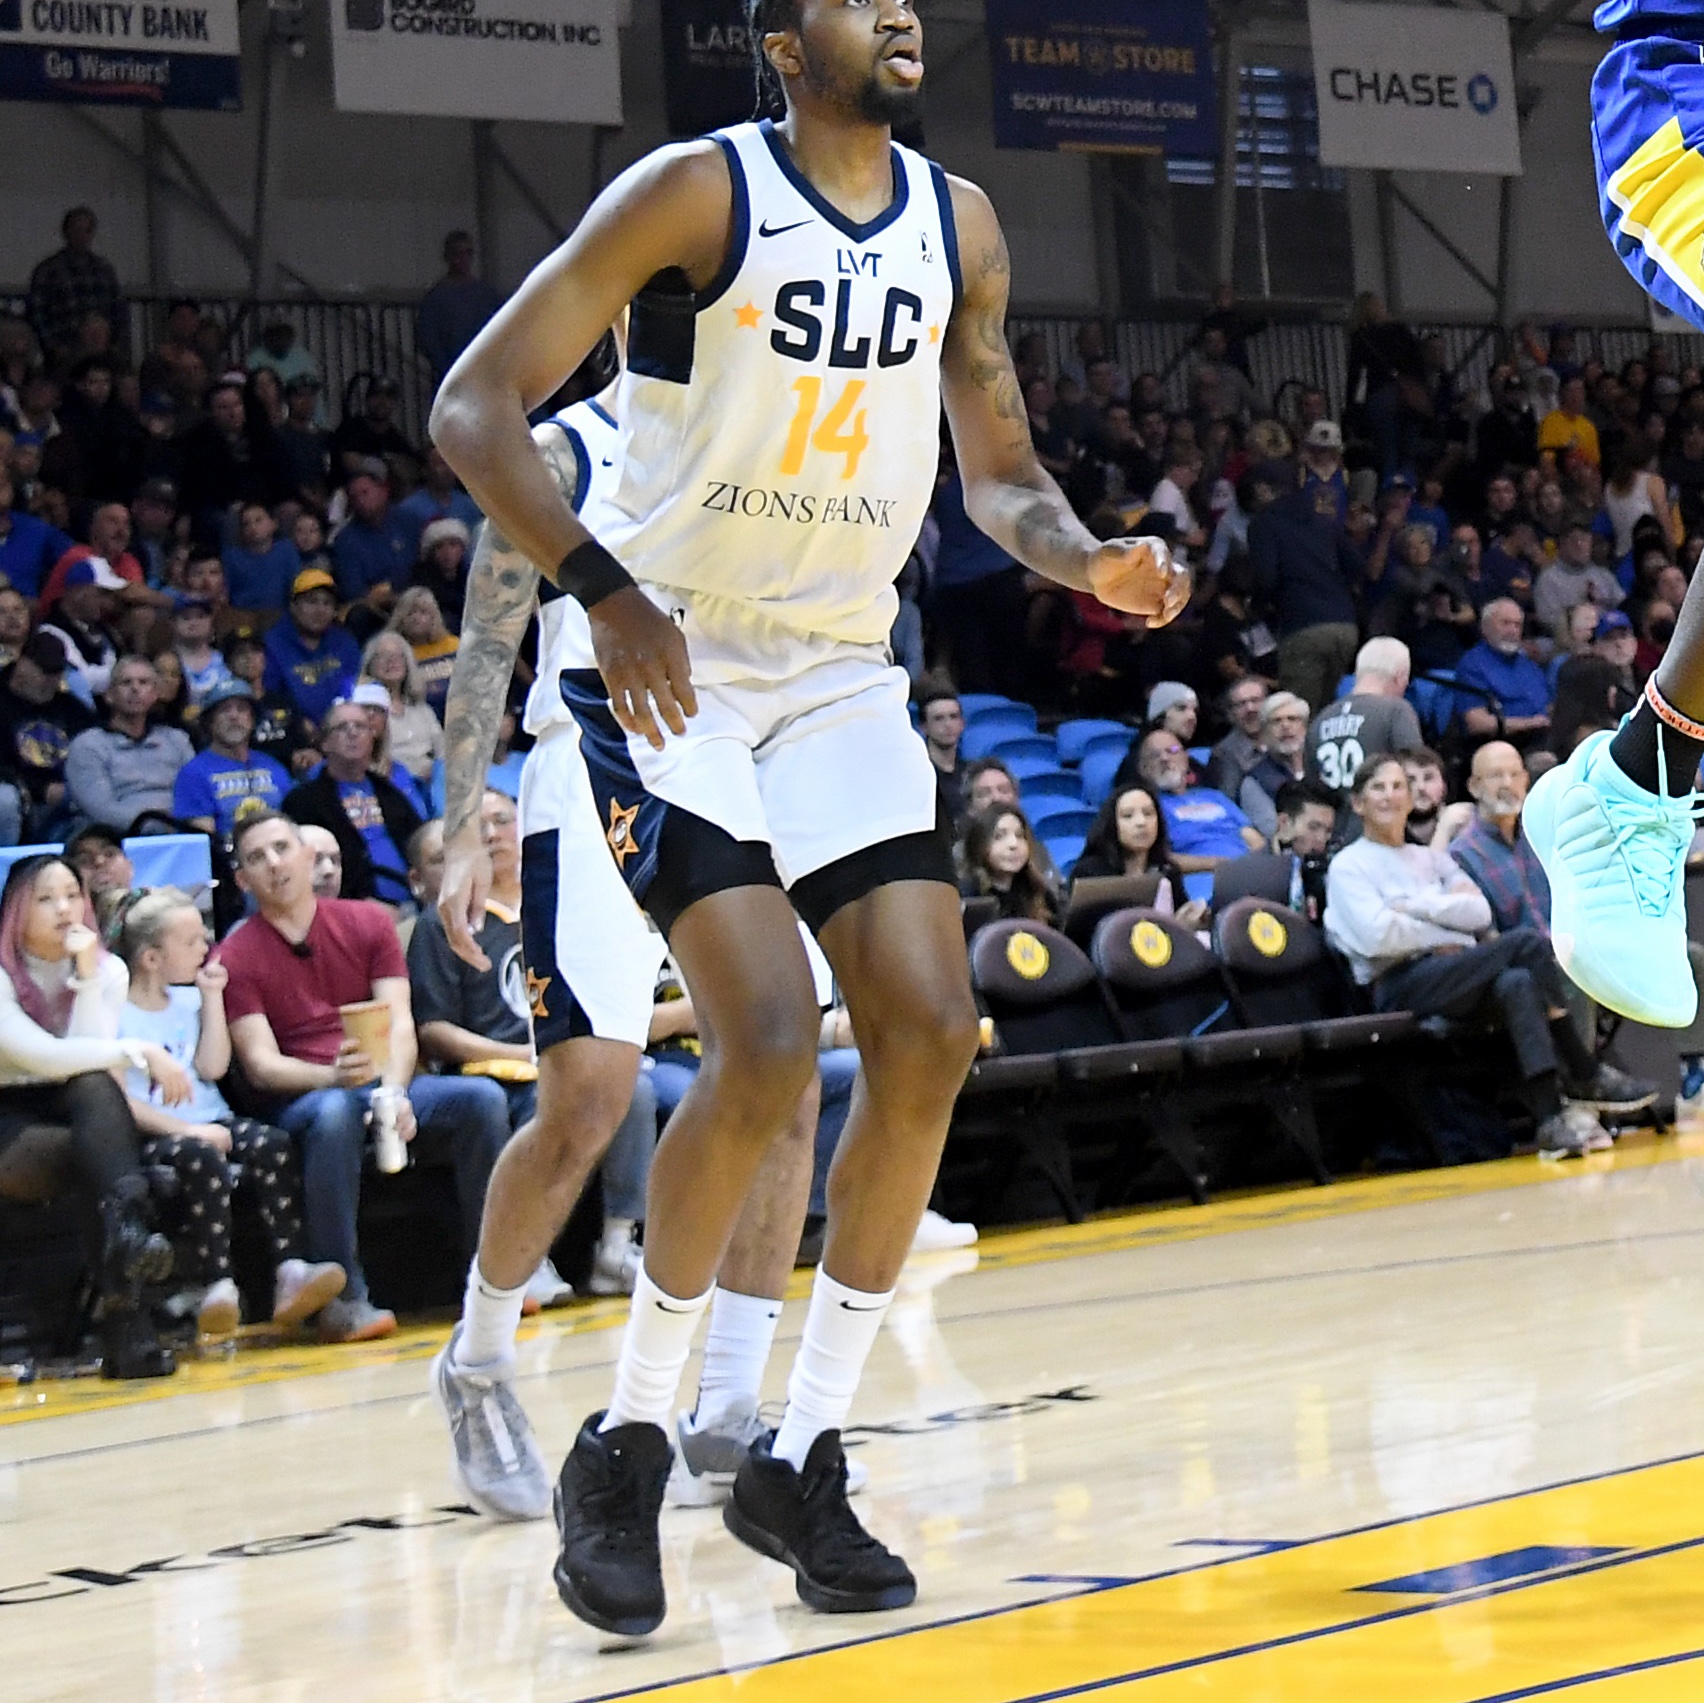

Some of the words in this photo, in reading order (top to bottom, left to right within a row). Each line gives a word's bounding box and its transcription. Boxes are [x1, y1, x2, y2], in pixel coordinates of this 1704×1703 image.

[32, 0, 132, 36] COUNTY
[142, 7, 209, 41] BANK
[563, 25, 601, 46] INC
[46, 51, 73, 79] Go
[1006, 37, 1079, 66] TEAM
[1113, 46, 1196, 74] STORE
[1331, 68, 1459, 108] CHASE
[770, 278, 923, 369] SLC
[779, 375, 870, 480] 14
[701, 481, 816, 524] ZIONS
[1316, 738, 1364, 789] 30
